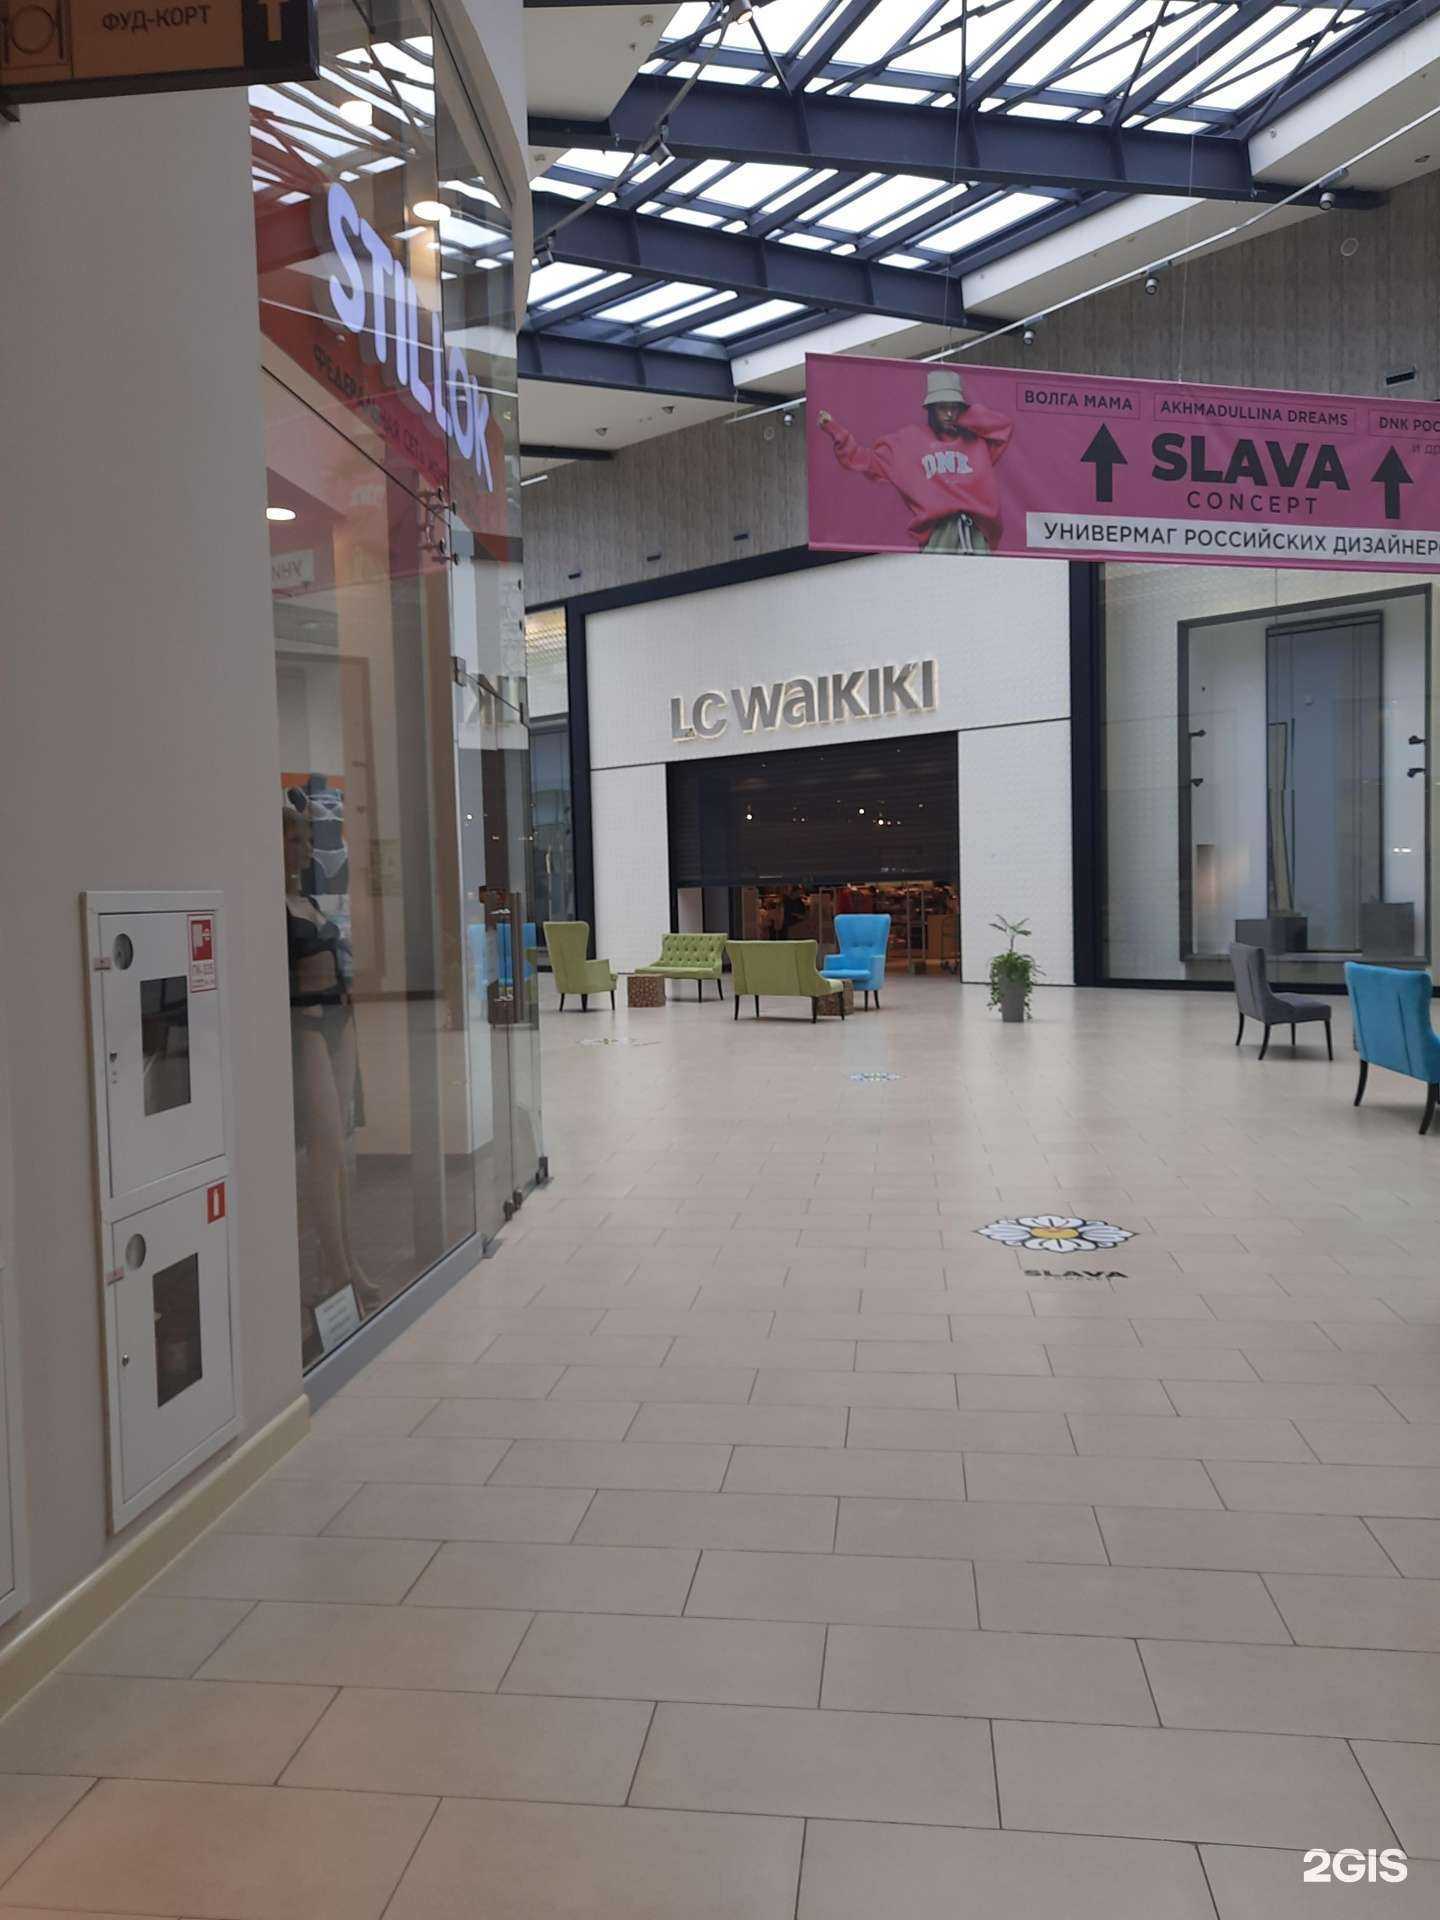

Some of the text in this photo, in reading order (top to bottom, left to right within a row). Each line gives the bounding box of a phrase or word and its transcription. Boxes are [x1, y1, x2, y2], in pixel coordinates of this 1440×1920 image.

[102, 5, 212, 33] ФУД-КОРТ
[1024, 390, 1134, 411] ВОЛГА МАМА
[1161, 400, 1349, 427] AKHMADULLINA DREAMS
[1379, 416, 1409, 431] DNK
[1151, 432, 1351, 491] SLAVA
[1186, 490, 1318, 516] CONCEPT
[1044, 520, 1440, 557] УНИВЕРМАГ РОССИЙСКИХ ДИЗАЙНЕР
[669, 692, 729, 742] LC
[1024, 1269, 1129, 1279] SLAVA
